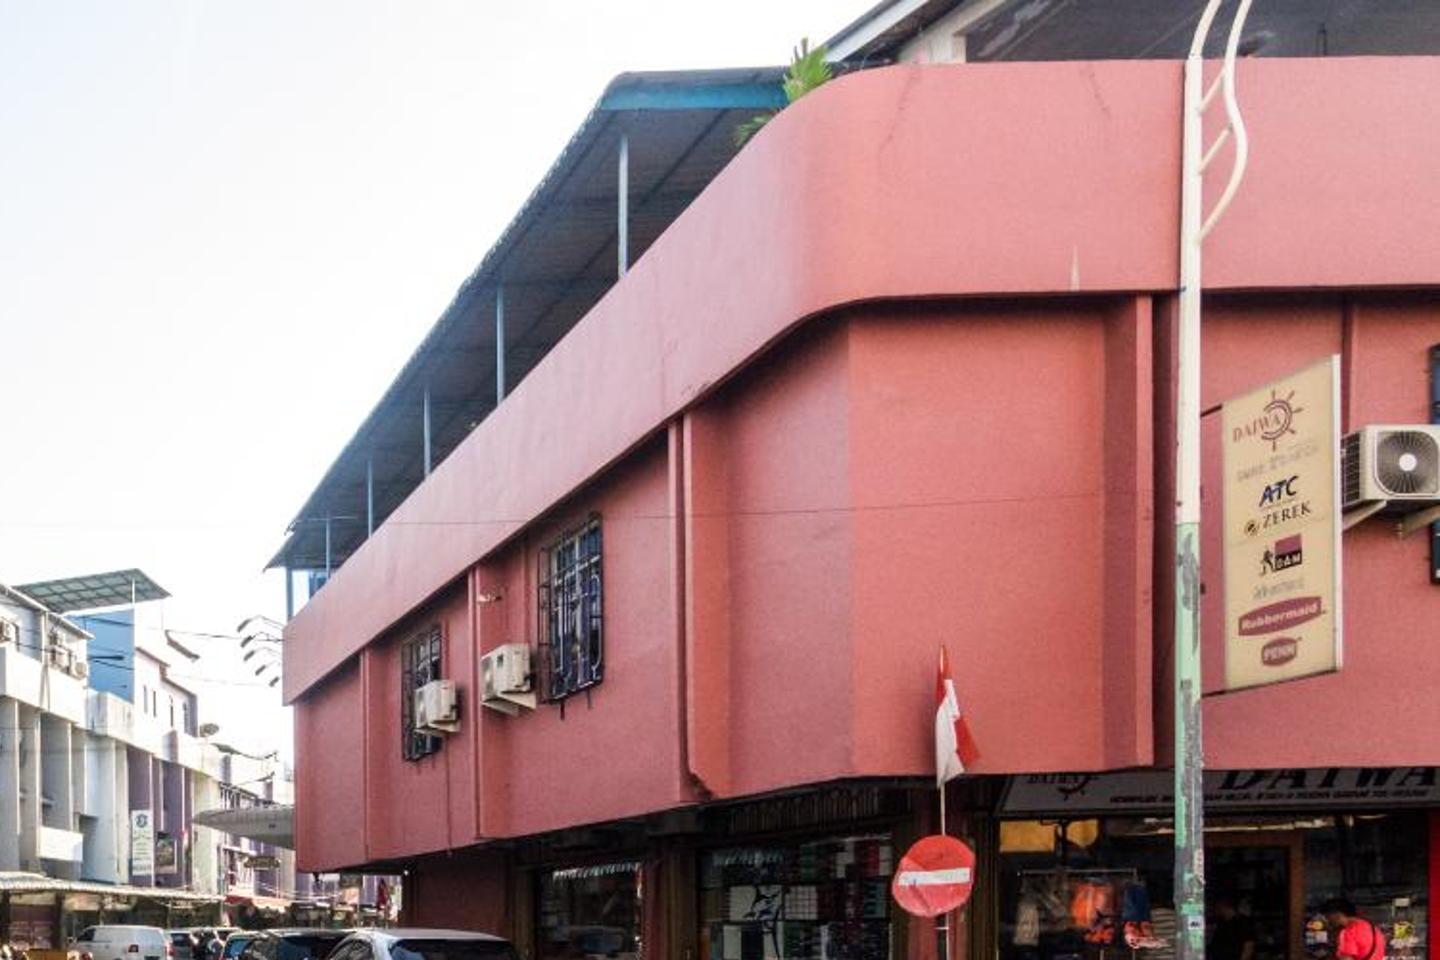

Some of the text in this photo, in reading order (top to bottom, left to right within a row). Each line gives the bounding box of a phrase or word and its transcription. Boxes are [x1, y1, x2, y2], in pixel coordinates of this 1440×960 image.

[1232, 413, 1283, 442] DAIWA
[1259, 475, 1299, 507] ATC
[1263, 501, 1312, 529] ZEREK
[1241, 602, 1318, 630] Rubbermaid
